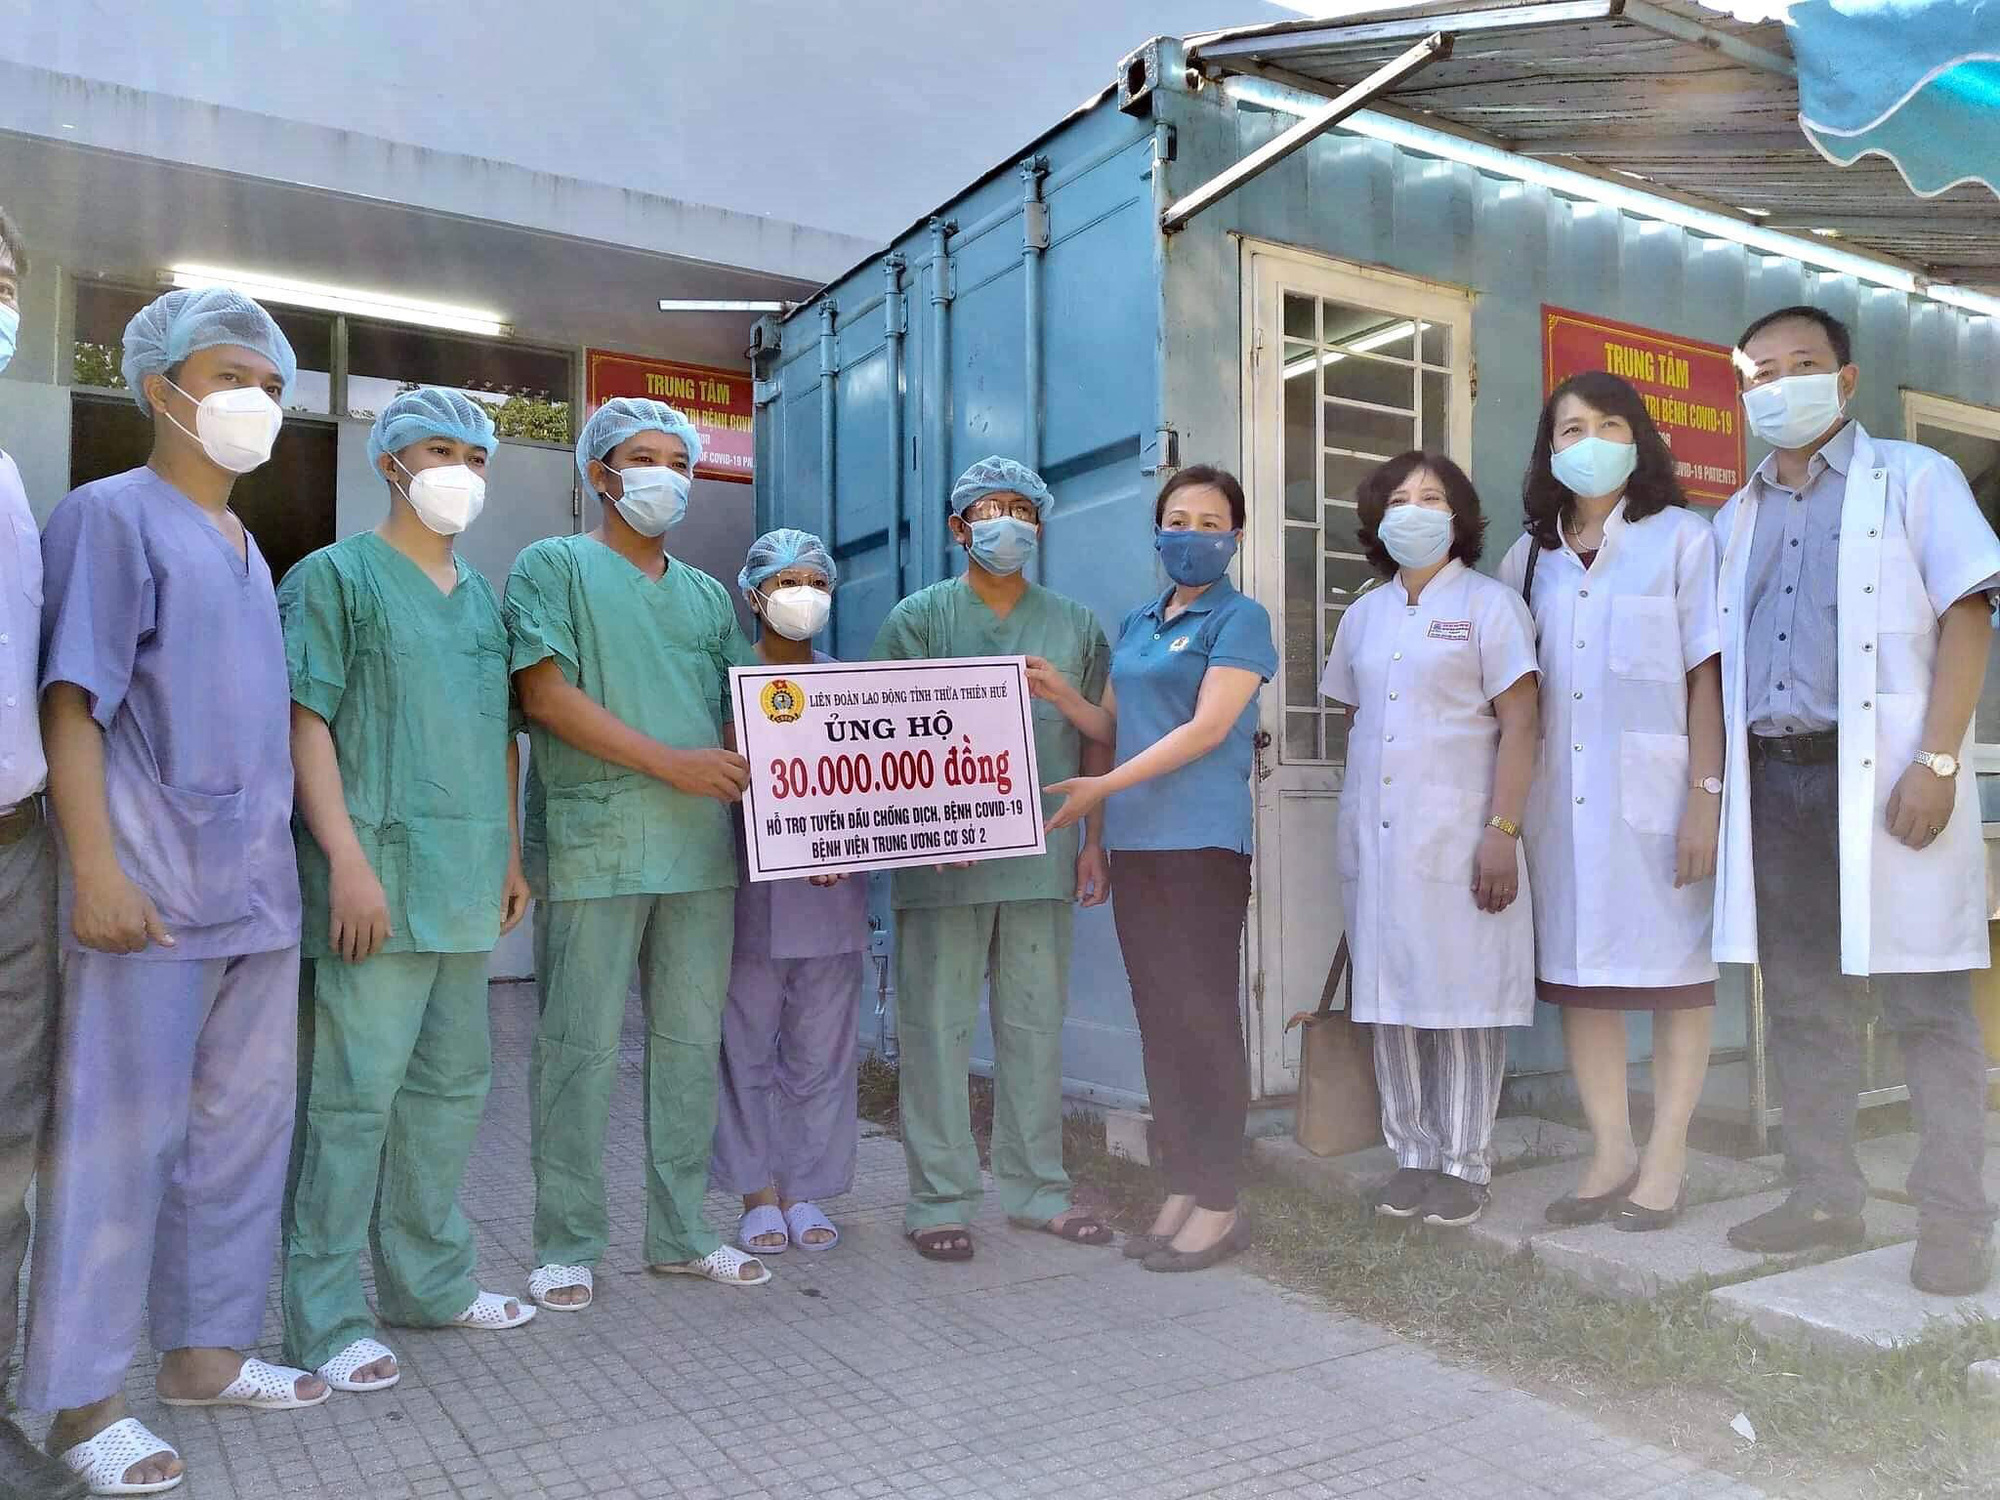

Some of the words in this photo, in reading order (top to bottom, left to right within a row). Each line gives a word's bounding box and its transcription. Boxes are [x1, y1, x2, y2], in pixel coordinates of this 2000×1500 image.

[1604, 342, 1654, 383] TRUNG
[1657, 350, 1689, 389] TÂM
[646, 373, 695, 400] TRUNG
[699, 377, 730, 405] TÂM
[1662, 394, 1688, 429] BỆNH
[1689, 403, 1733, 435] COVID-19
[709, 452, 742, 467] COVID-19
[1703, 465, 1737, 485] PATIENTS
[809, 691, 831, 707] LIÊN
[834, 689, 859, 706] ĐOÀN
[862, 691, 880, 705] LAO
[882, 688, 907, 706] ĐỘNG
[960, 683, 987, 700] THIÊN
[989, 680, 1008, 698] HUẾ
[824, 713, 896, 742] ỦNG
[907, 709, 953, 740] HỘ
[770, 749, 934, 799] 30.000.000
[944, 734, 1012, 795] đồng
[766, 811, 781, 836] HỖ
[785, 816, 807, 836] TRỢ
[873, 804, 910, 826] CHỐNG
[912, 805, 941, 827] DỊCH,
[944, 800, 972, 824] BỆNH
[975, 799, 1023, 818] COVID-19
[812, 838, 841, 861] BỆNH
[844, 834, 869, 858] VIỆN
[872, 834, 908, 853] TRUNG
[910, 831, 941, 849] ƯƠNG
[944, 829, 958, 846] CƠ
[961, 823, 976, 845] SỞ
[979, 827, 987, 843] 2
